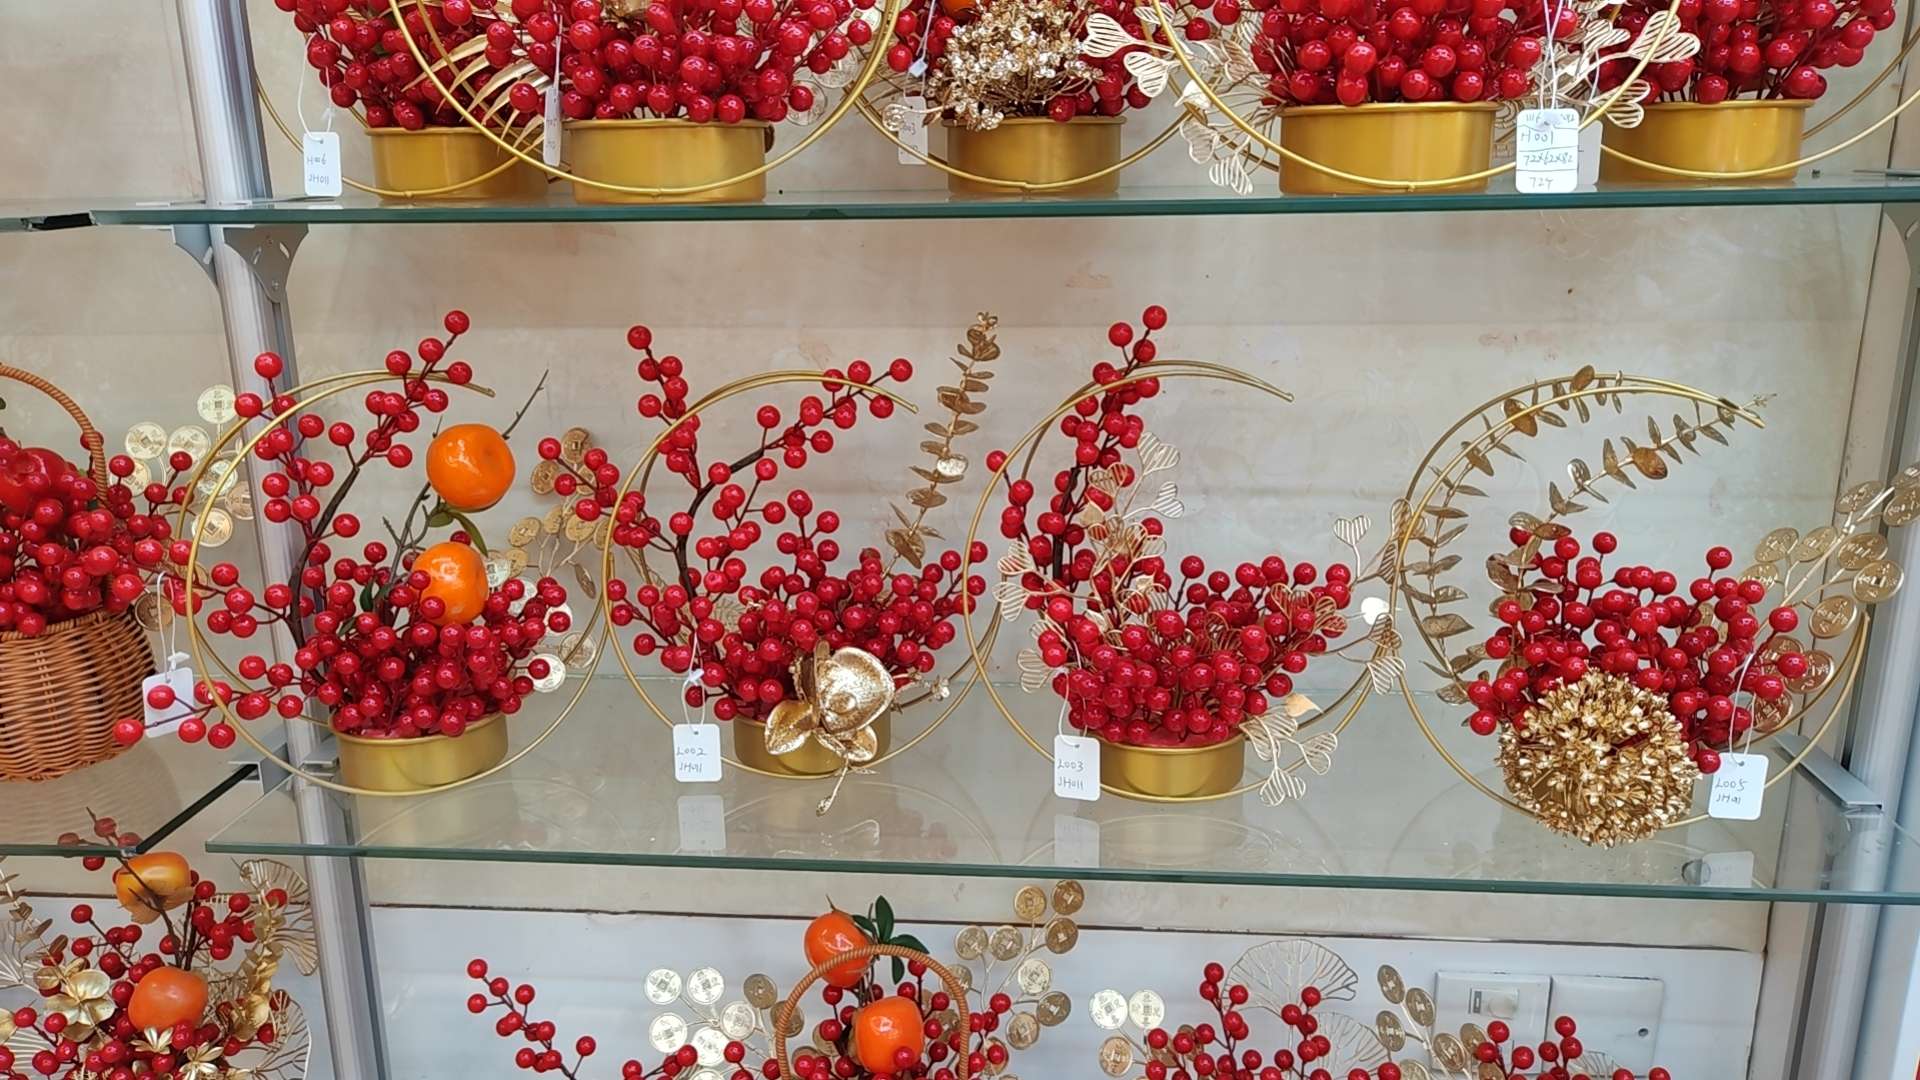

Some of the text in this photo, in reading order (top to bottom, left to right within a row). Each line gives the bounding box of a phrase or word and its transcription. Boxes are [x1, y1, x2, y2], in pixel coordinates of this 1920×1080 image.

[1521, 127, 1554, 145] H001
[676, 746, 708, 757] L002
[1057, 758, 1084, 772] L003
[1714, 777, 1750, 792] L005
